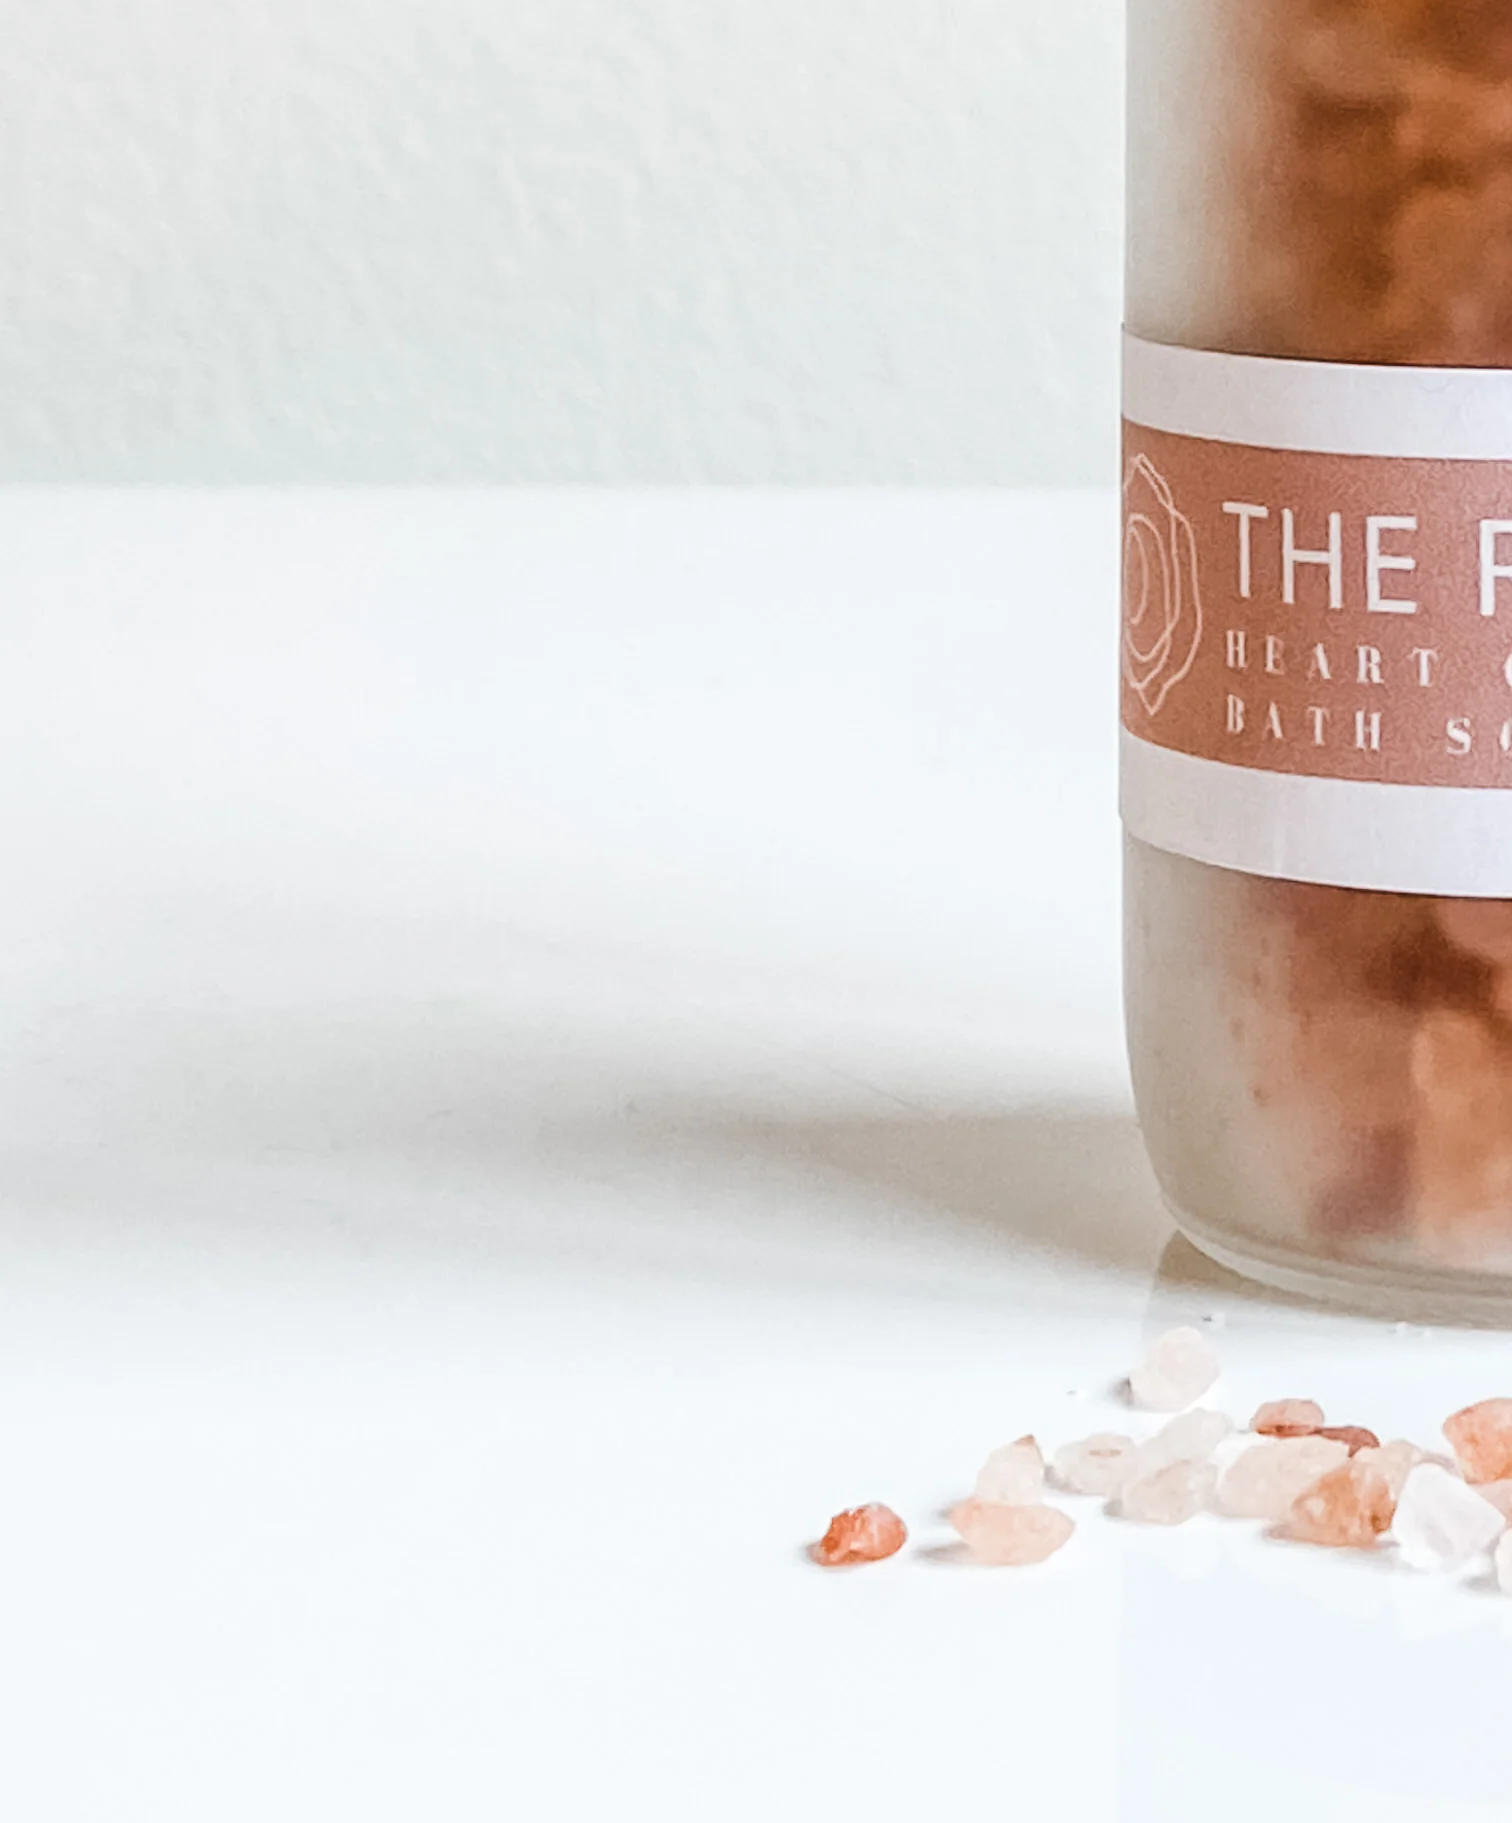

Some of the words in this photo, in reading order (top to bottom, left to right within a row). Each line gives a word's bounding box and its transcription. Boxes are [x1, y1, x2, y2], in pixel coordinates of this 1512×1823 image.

[1222, 500, 1420, 617] THE
[1226, 630, 1439, 687] HEART
[1225, 693, 1383, 753] BATH
